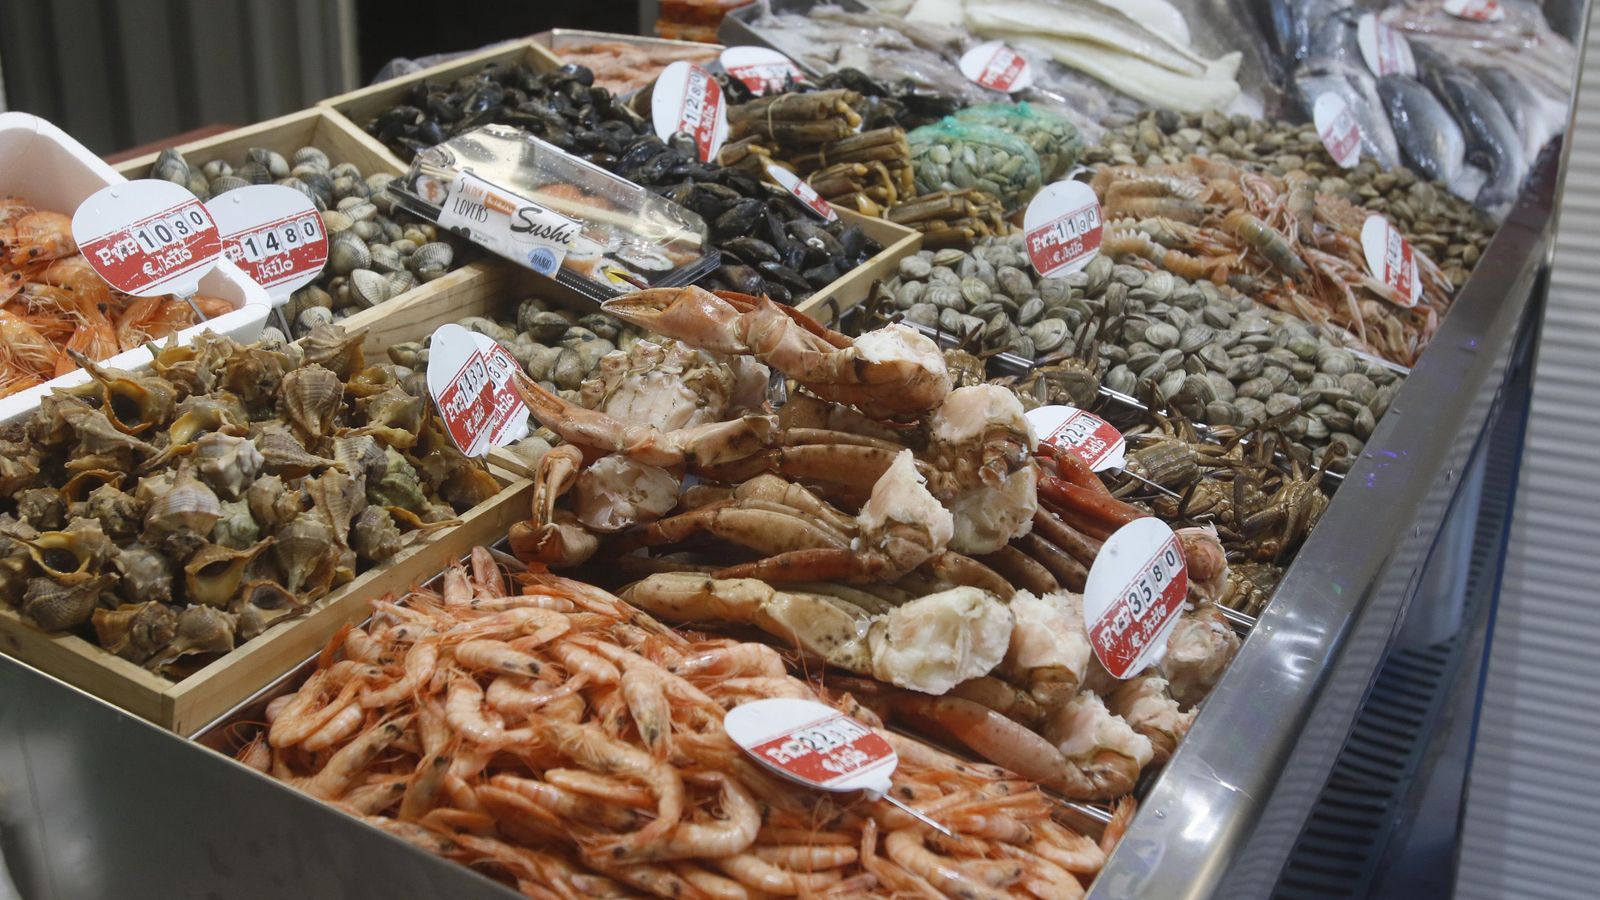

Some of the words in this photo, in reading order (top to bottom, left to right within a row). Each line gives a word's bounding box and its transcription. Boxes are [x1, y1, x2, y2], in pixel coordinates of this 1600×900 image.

[453, 197, 489, 223] LOVERS
[510, 207, 575, 245] Sushi
[245, 222, 315, 257] 1480
[1128, 550, 1175, 616] 3580
